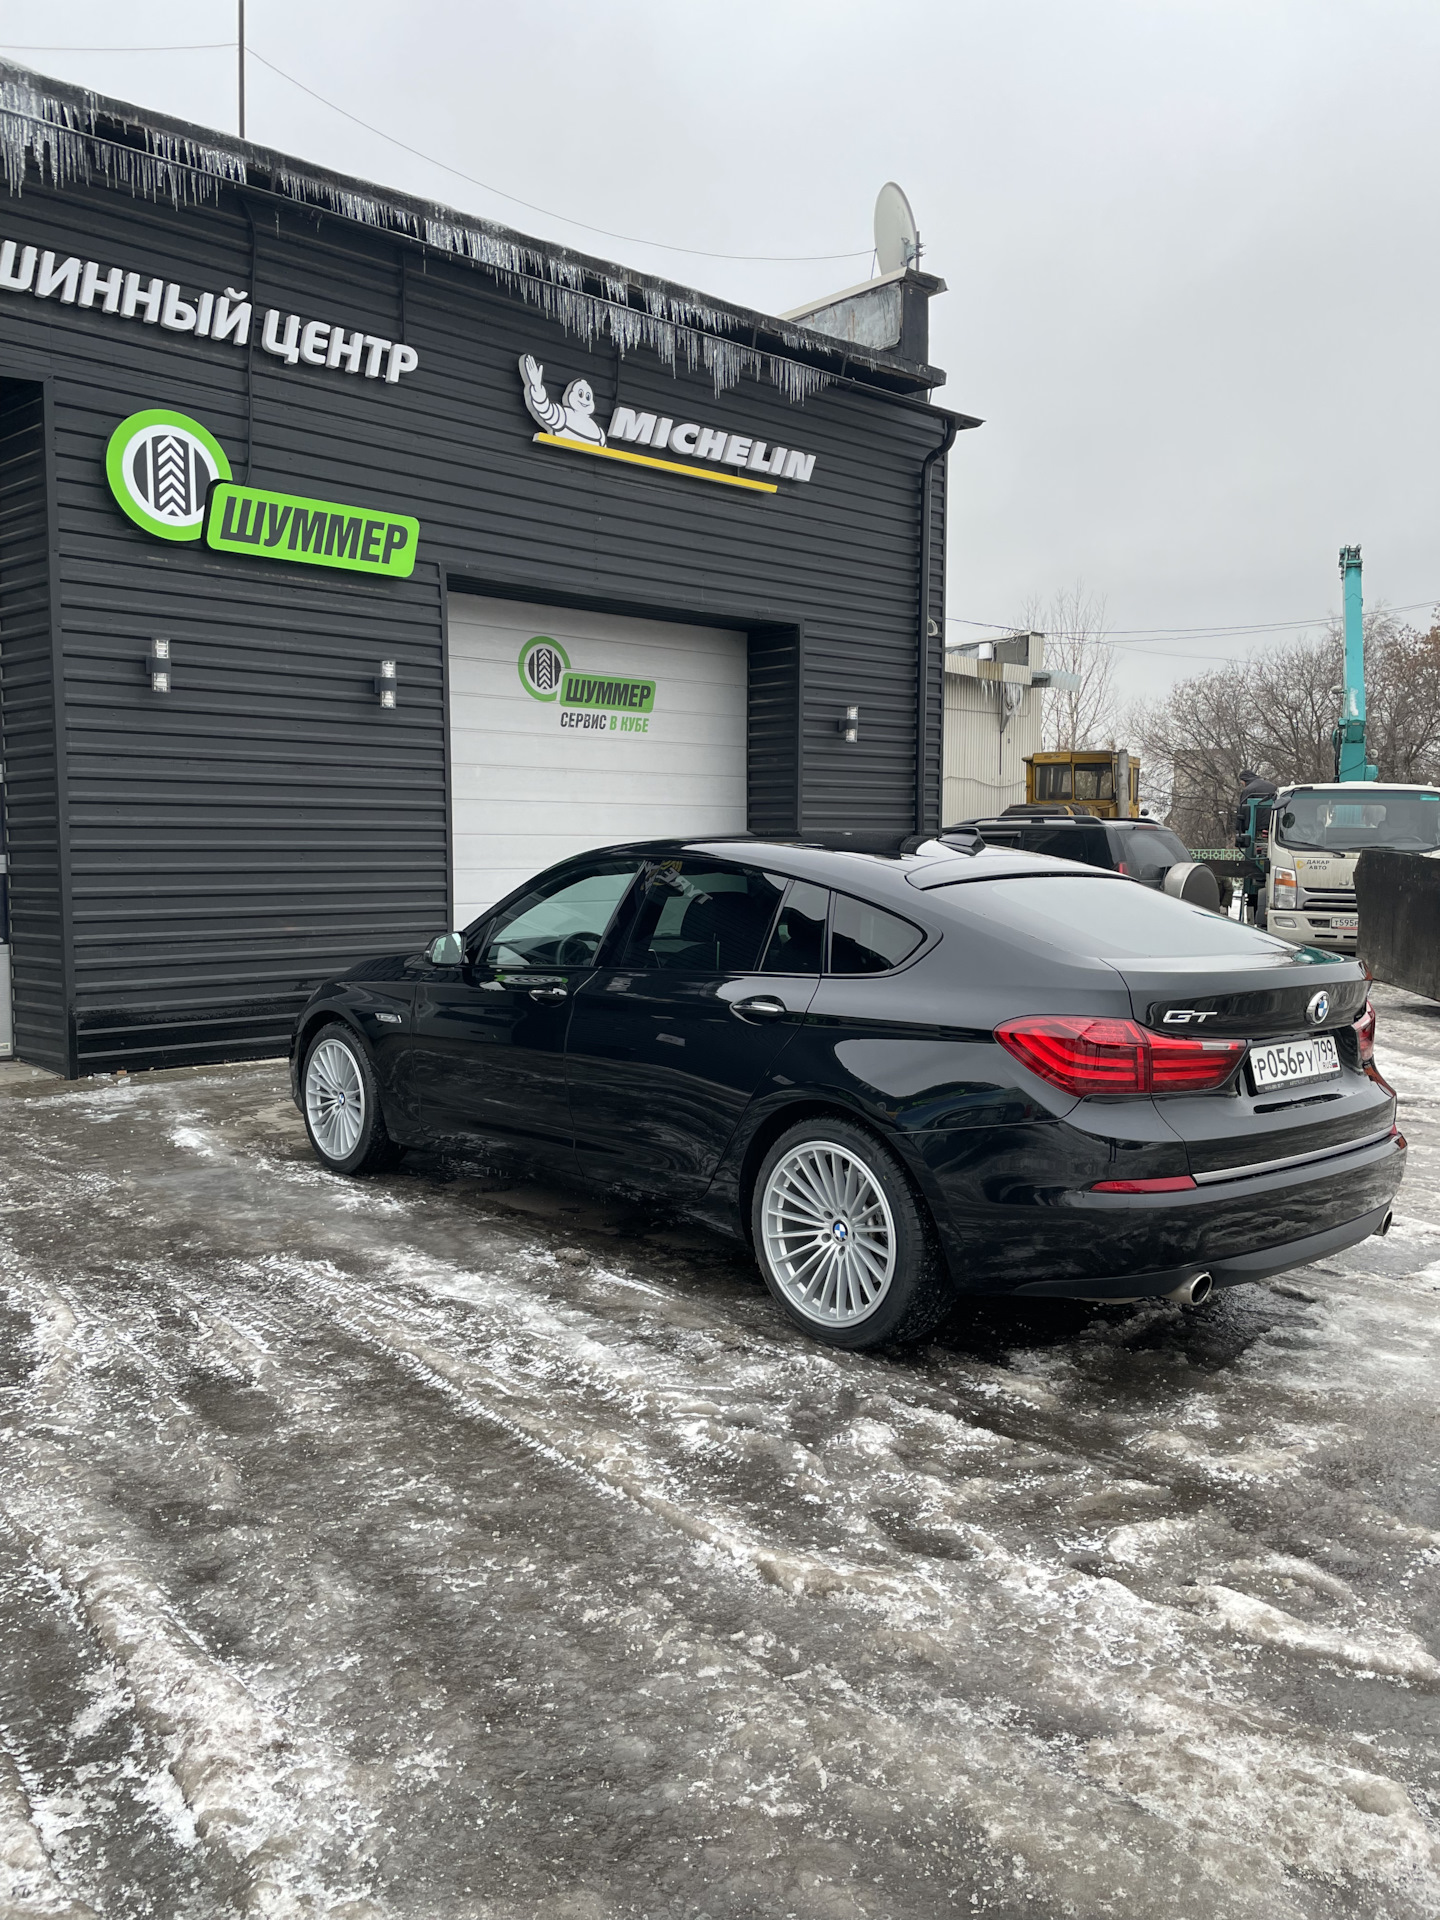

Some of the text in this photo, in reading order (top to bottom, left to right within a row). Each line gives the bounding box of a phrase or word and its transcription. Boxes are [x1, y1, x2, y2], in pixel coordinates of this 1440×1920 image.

[0, 239, 419, 384] ШИННЫЙ ЦЕНТР
[606, 406, 817, 482] MICHELIN
[219, 495, 409, 565] ШУММЕР
[565, 678, 652, 708] ШУММЕР
[560, 711, 650, 733] СЕРВИС В КУБЕ
[1162, 1009, 1218, 1024] GT
[1313, 1039, 1334, 1062] 799
